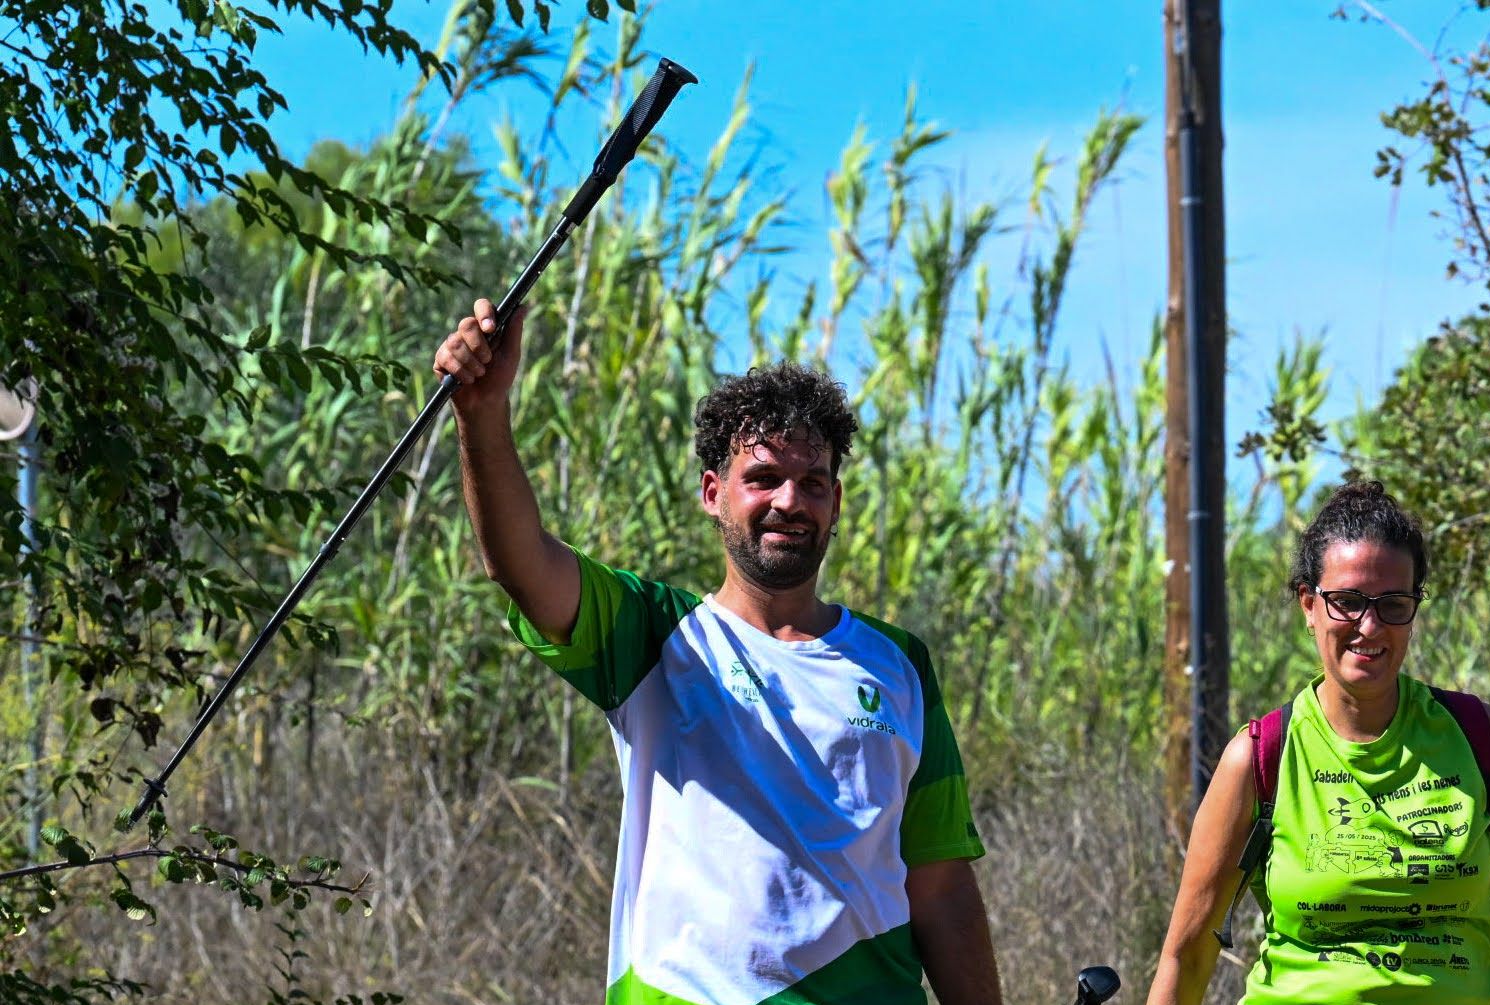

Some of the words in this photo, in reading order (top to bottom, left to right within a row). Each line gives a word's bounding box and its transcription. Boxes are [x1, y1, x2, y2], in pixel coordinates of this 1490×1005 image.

[847, 716, 896, 735] vidrala
[1388, 786, 1411, 803] nens
[1418, 779, 1432, 792] les
[1434, 774, 1461, 790] nenes
[1396, 801, 1463, 822] PATROCINADORS
